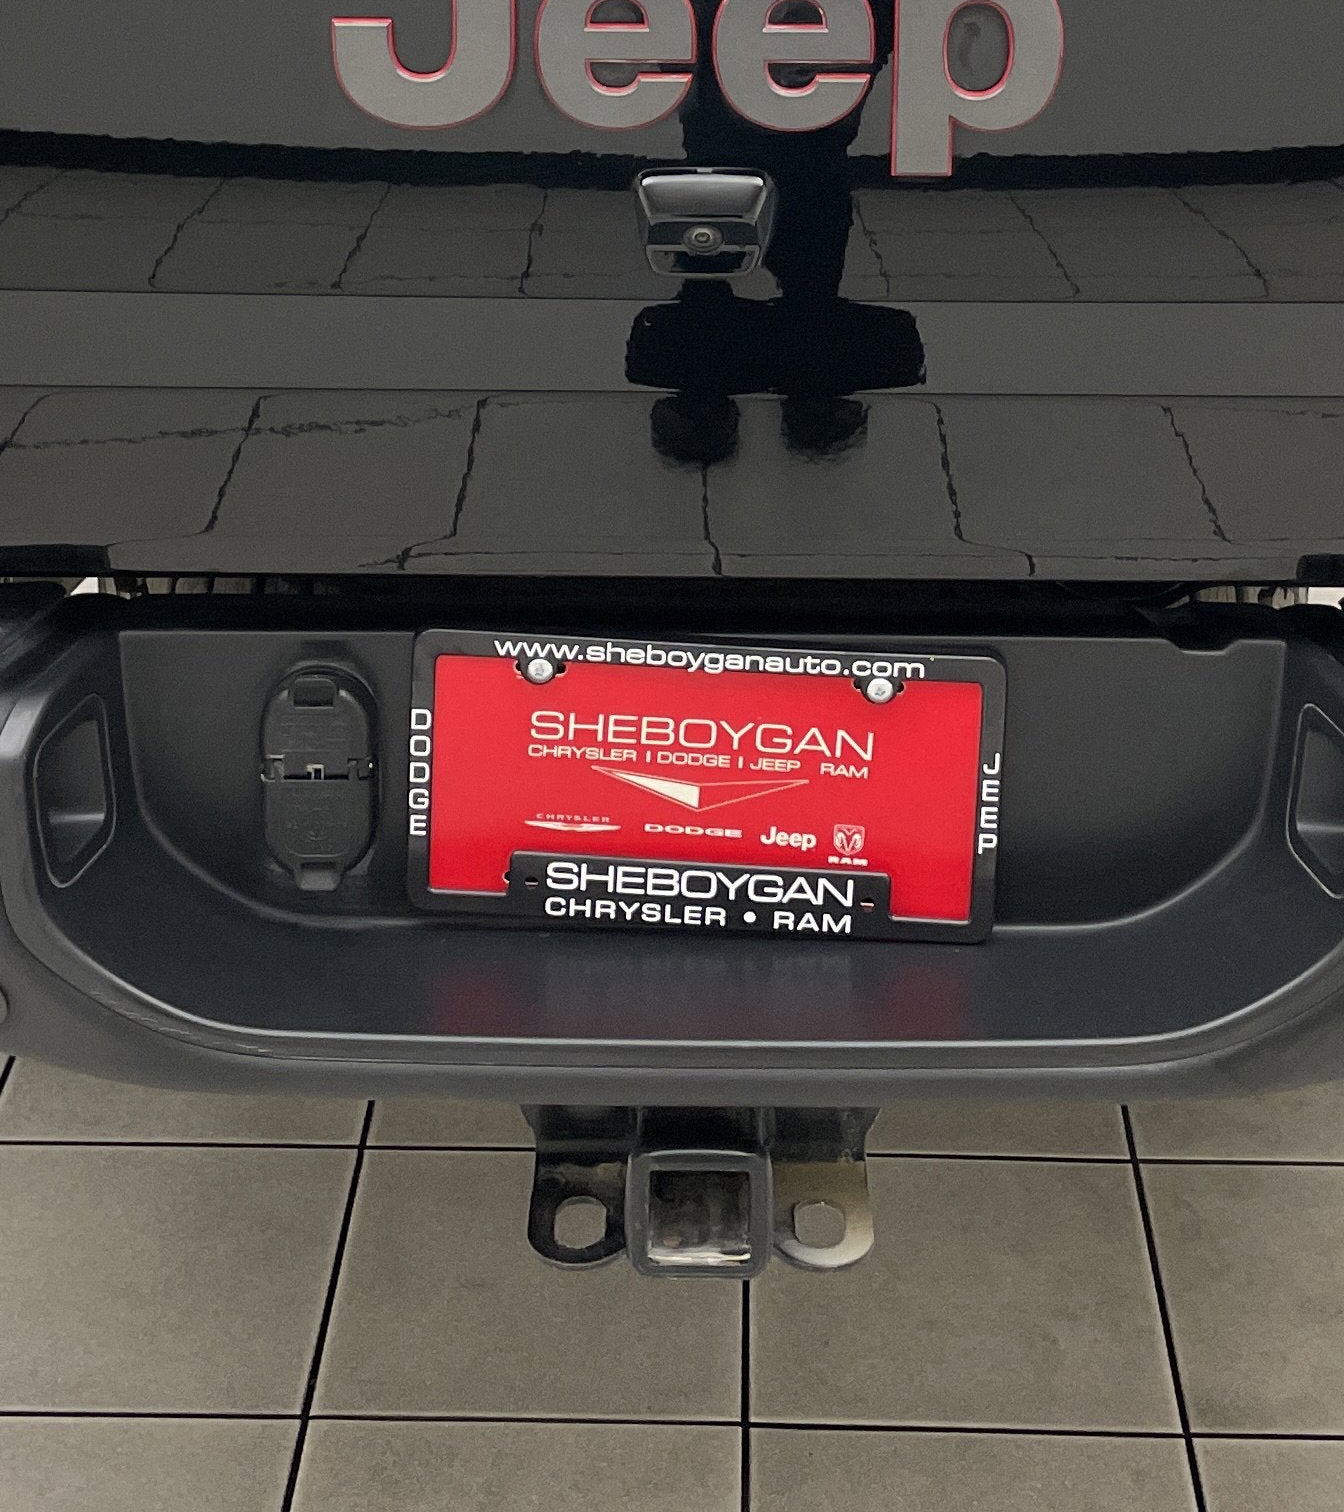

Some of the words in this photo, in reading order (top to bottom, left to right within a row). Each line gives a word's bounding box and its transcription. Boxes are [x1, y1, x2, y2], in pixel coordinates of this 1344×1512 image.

[493, 639, 925, 679] www.sheboyganauto.com
[530, 710, 875, 762] SHEBOYGAN
[408, 708, 432, 837] DODGE
[527, 744, 637, 763] CHRYSLER
[656, 751, 731, 769] DODGE
[749, 757, 801, 773] JEEP
[819, 762, 870, 780] RAM
[535, 813, 611, 823] CHRYSLER
[977, 752, 1001, 855] JEEP
[644, 823, 743, 838] DODGE
[759, 825, 818, 852] Jeep
[827, 855, 869, 867] RAM
[545, 861, 855, 907] SHEBOYGAN
[544, 896, 727, 927] CHRYSLER
[772, 910, 852, 934] RAM
